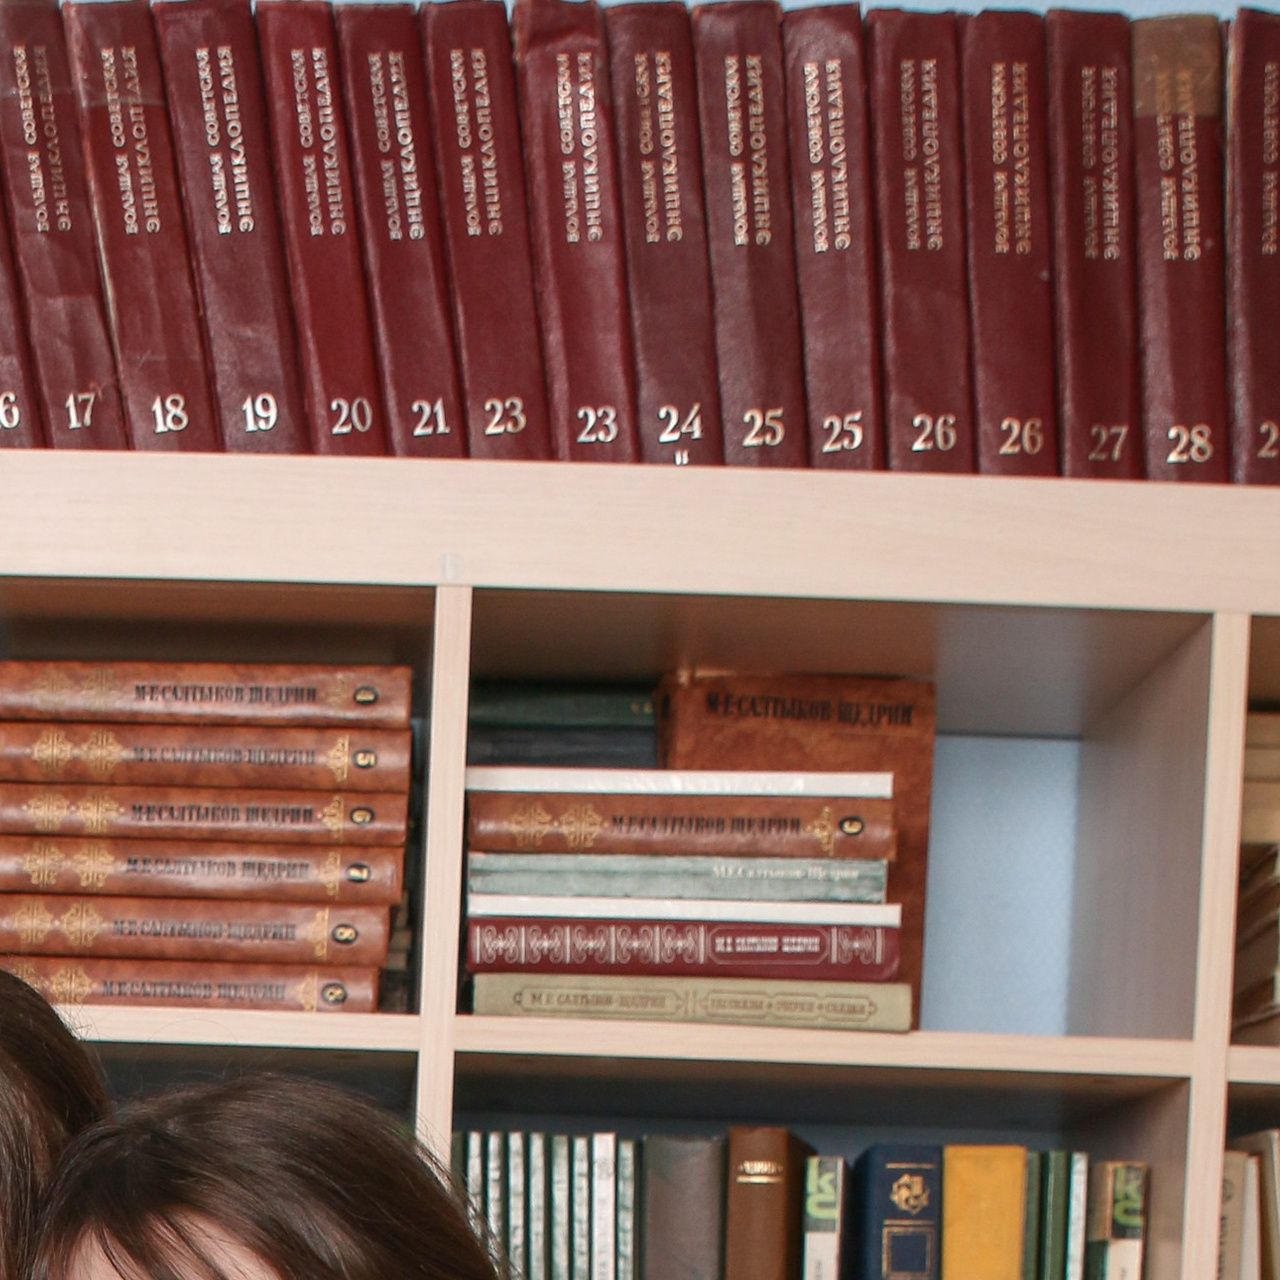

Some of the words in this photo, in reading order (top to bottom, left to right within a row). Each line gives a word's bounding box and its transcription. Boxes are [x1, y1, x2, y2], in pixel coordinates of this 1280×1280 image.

[196, 48, 220, 147] СОВЕТСКАЯ
[804, 62, 824, 164] СОВЕТСКАЯ
[218, 46, 254, 232] ЭНЦИКЛОПЕДИЯ
[825, 60, 851, 251] ЭНЦИКЛОПЕДИЯ
[209, 153, 232, 235] БОЛЬШАЯ
[810, 170, 829, 253] БОЛЬШАЯ
[65, 393, 96, 429] 17
[152, 394, 189, 433] 18
[242, 393, 277, 432] 19
[331, 397, 372, 435] 20
[412, 397, 451, 436] 21
[484, 397, 526, 435] 23
[577, 406, 618, 443] 23
[658, 403, 702, 443] 24
[742, 408, 784, 447] 25
[822, 411, 863, 452] 25
[911, 414, 957, 452] 26
[999, 418, 1043, 455] 26
[1089, 425, 1128, 461] 27
[1167, 425, 1213, 464] 28
